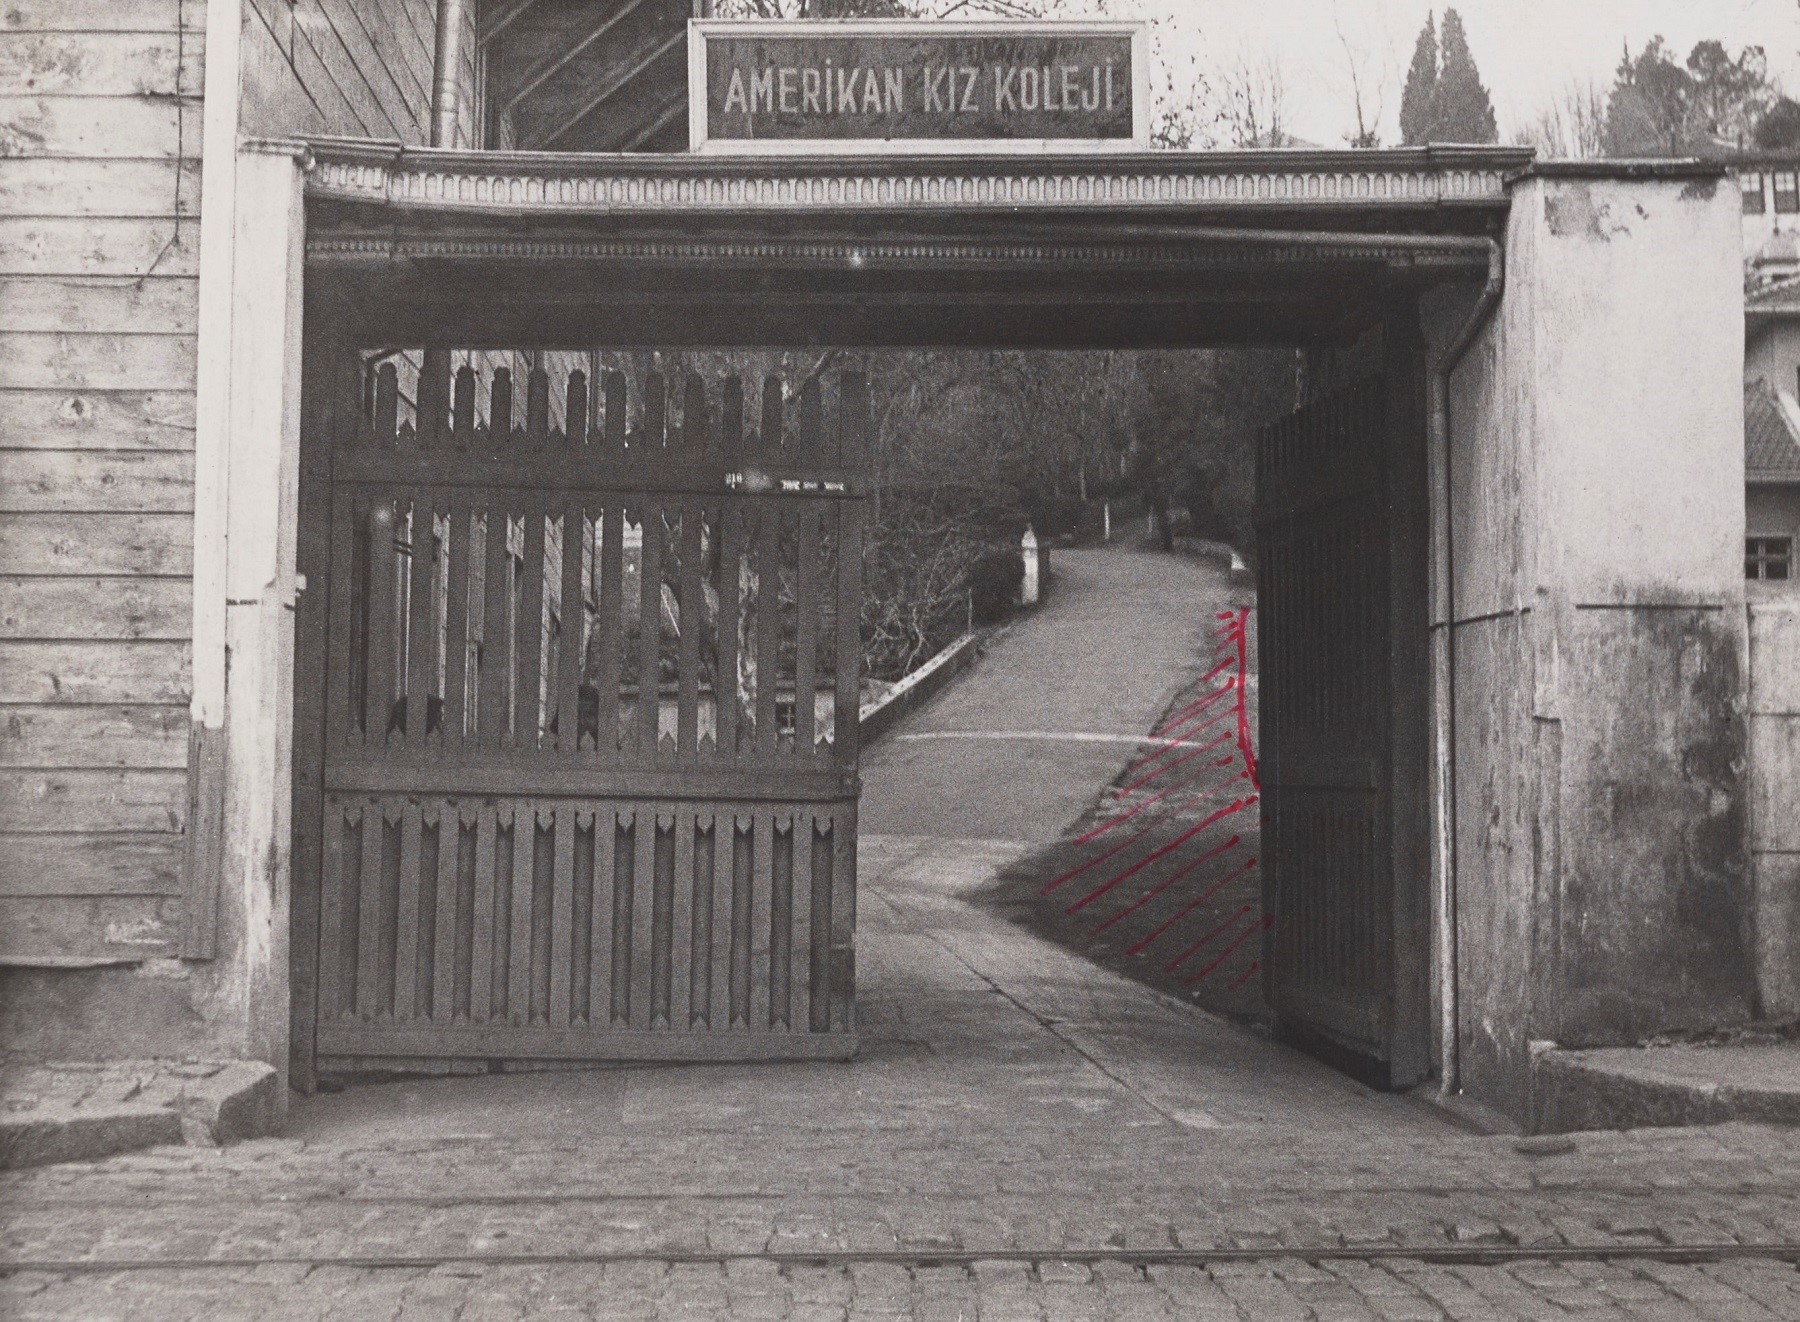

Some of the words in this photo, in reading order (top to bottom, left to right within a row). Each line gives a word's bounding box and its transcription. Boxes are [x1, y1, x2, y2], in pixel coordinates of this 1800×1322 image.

[724, 58, 903, 113] AMERİKAN
[923, 66, 980, 112] KIZ
[994, 57, 1113, 112] KOLEJİ
